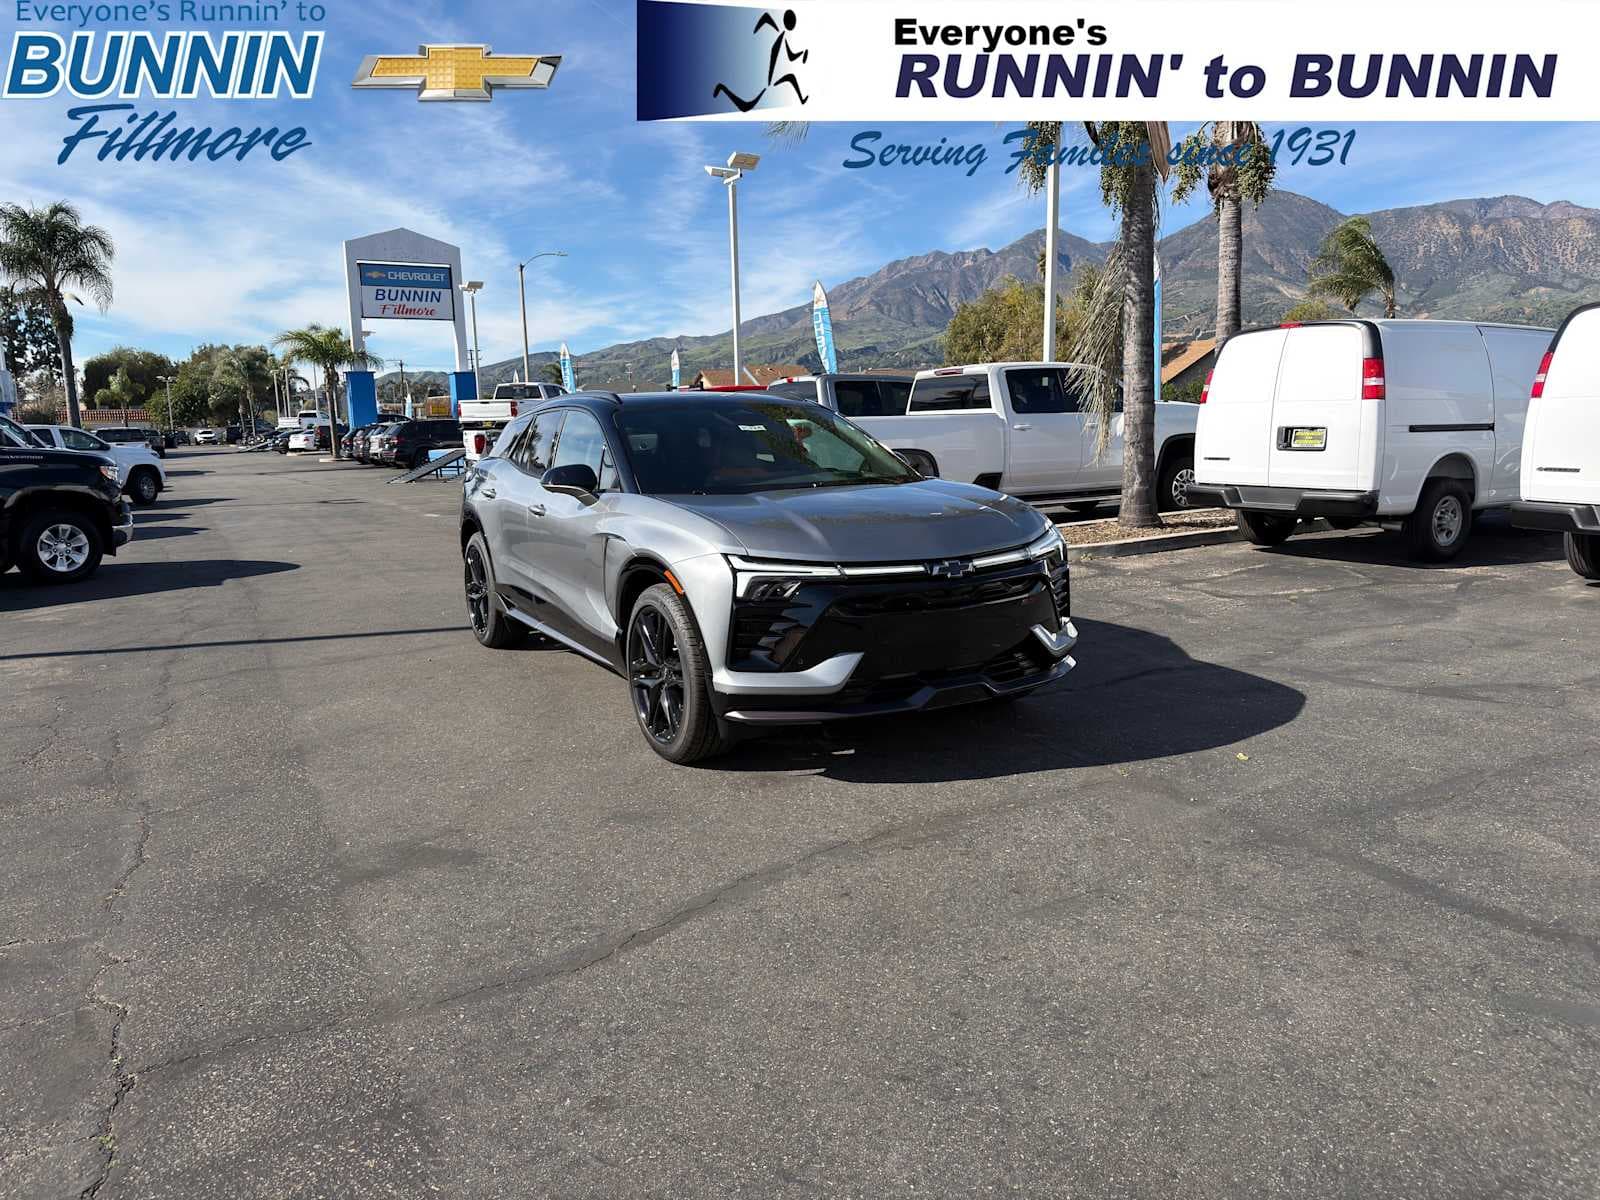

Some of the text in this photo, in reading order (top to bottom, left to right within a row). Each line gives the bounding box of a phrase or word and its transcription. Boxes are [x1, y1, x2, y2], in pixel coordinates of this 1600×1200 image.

[387, 271, 446, 282] CHEVROLET
[375, 288, 442, 303] BUNNIN
[380, 303, 436, 316] Fillmore
